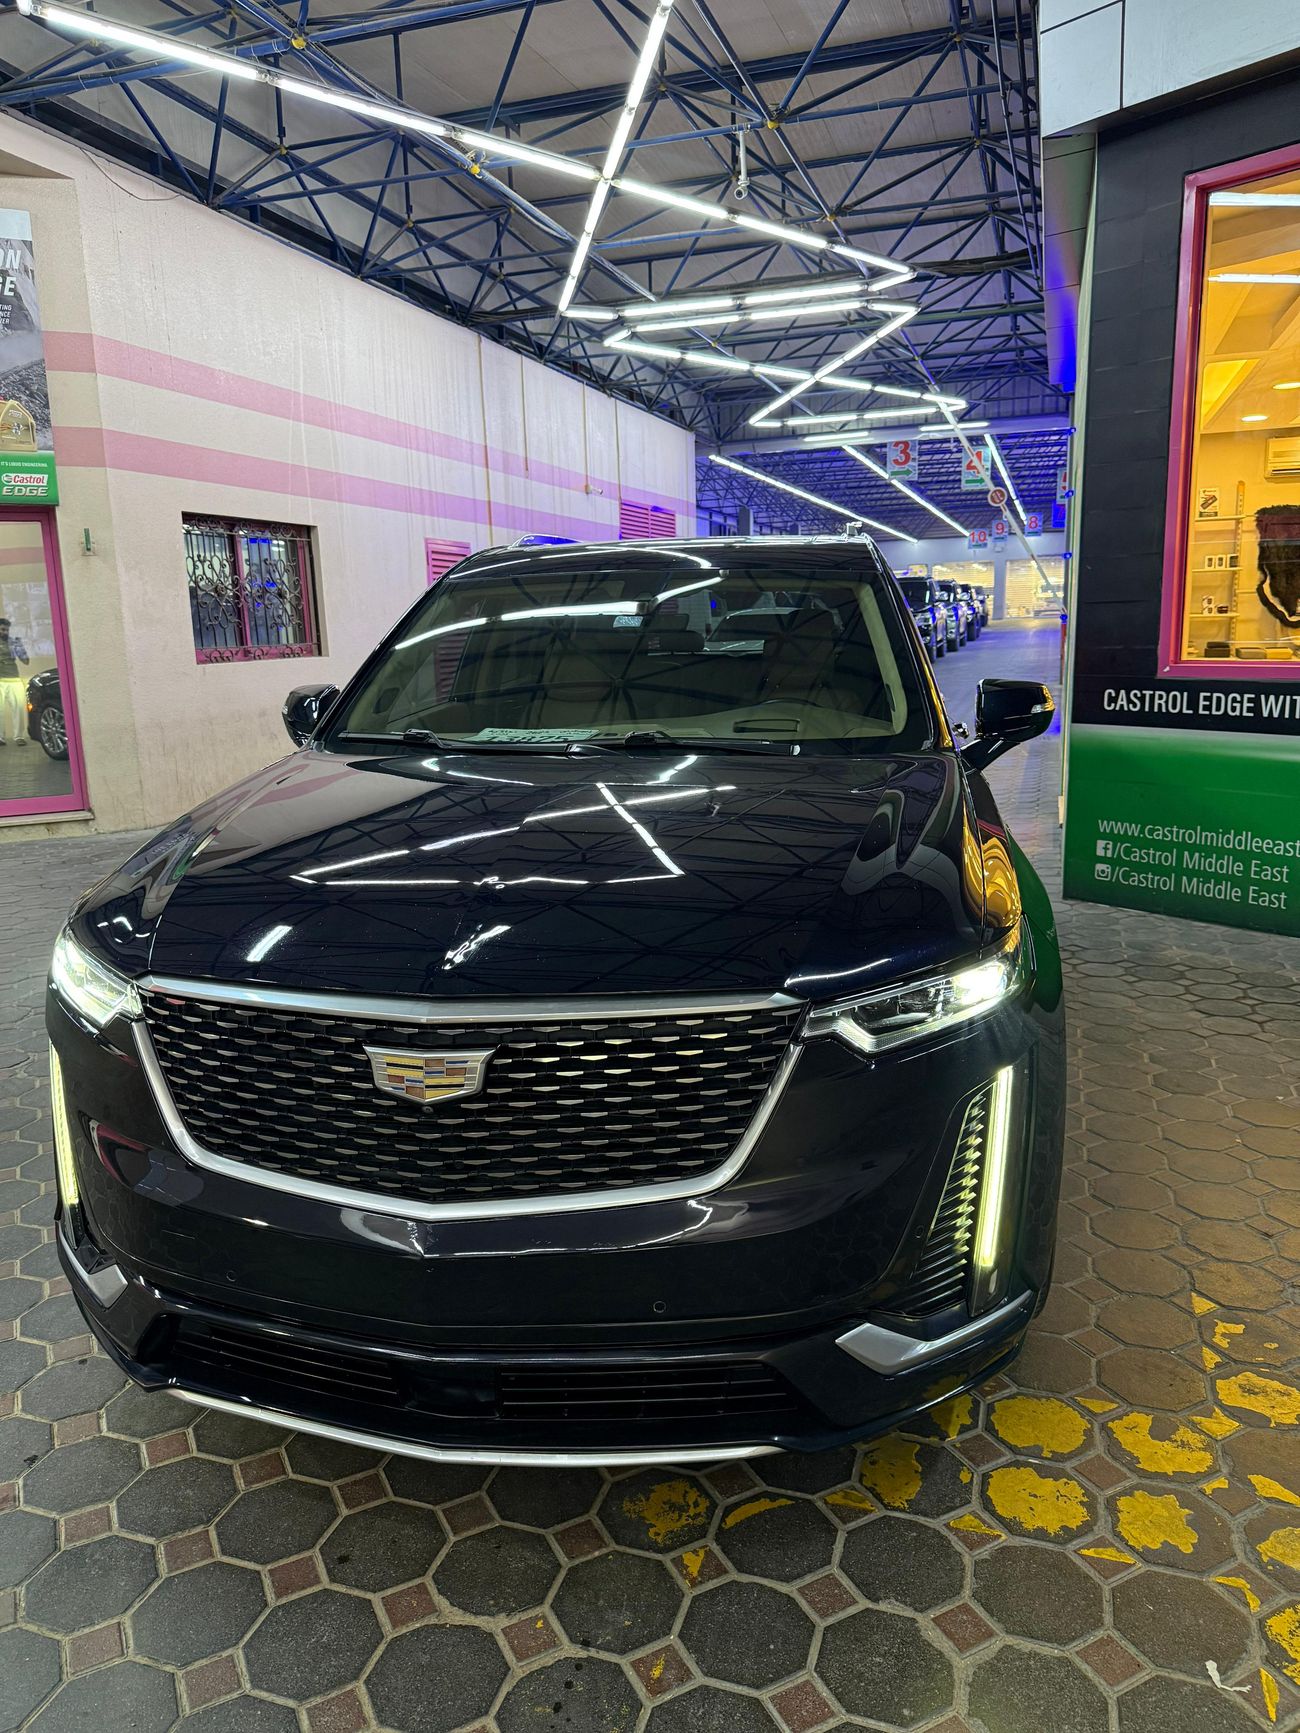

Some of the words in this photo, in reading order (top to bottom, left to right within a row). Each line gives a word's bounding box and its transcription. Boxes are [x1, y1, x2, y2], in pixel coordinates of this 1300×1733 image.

[892, 440, 911, 467] 3
[965, 450, 985, 475] 4
[13, 474, 45, 484] Castrol
[2, 486, 48, 497] EDGE
[995, 522, 1004, 535] 9
[1028, 515, 1038, 529] 8
[969, 530, 987, 542] 10
[1103, 688, 1193, 714] CASTROL
[1198, 692, 1255, 717] EDGE
[1183, 851, 1243, 876] Middle
[1250, 860, 1290, 883] East
[1181, 876, 1241, 901] Middle
[1248, 886, 1287, 909] East
